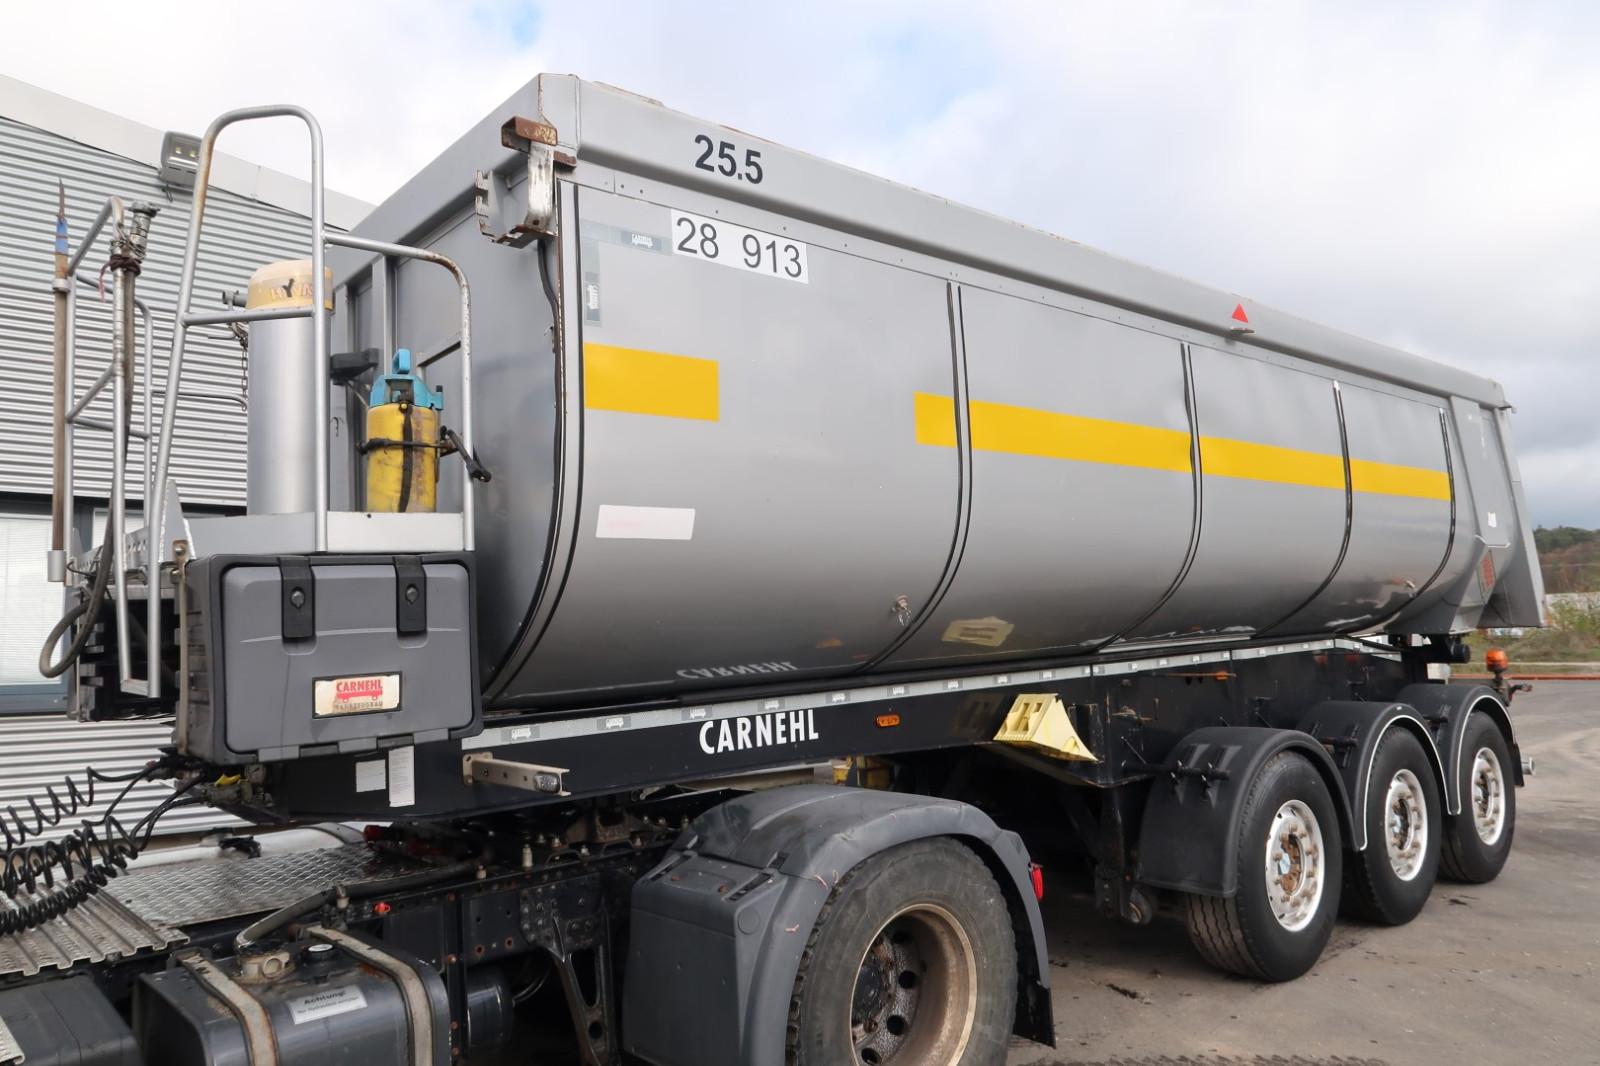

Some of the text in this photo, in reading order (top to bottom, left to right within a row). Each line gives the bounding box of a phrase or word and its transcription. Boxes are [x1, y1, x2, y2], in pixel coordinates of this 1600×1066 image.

[694, 134, 763, 184] 25.5
[677, 217, 801, 277] 28 913
[336, 679, 383, 692] CARNEHL
[699, 709, 819, 754] CARNEHL
